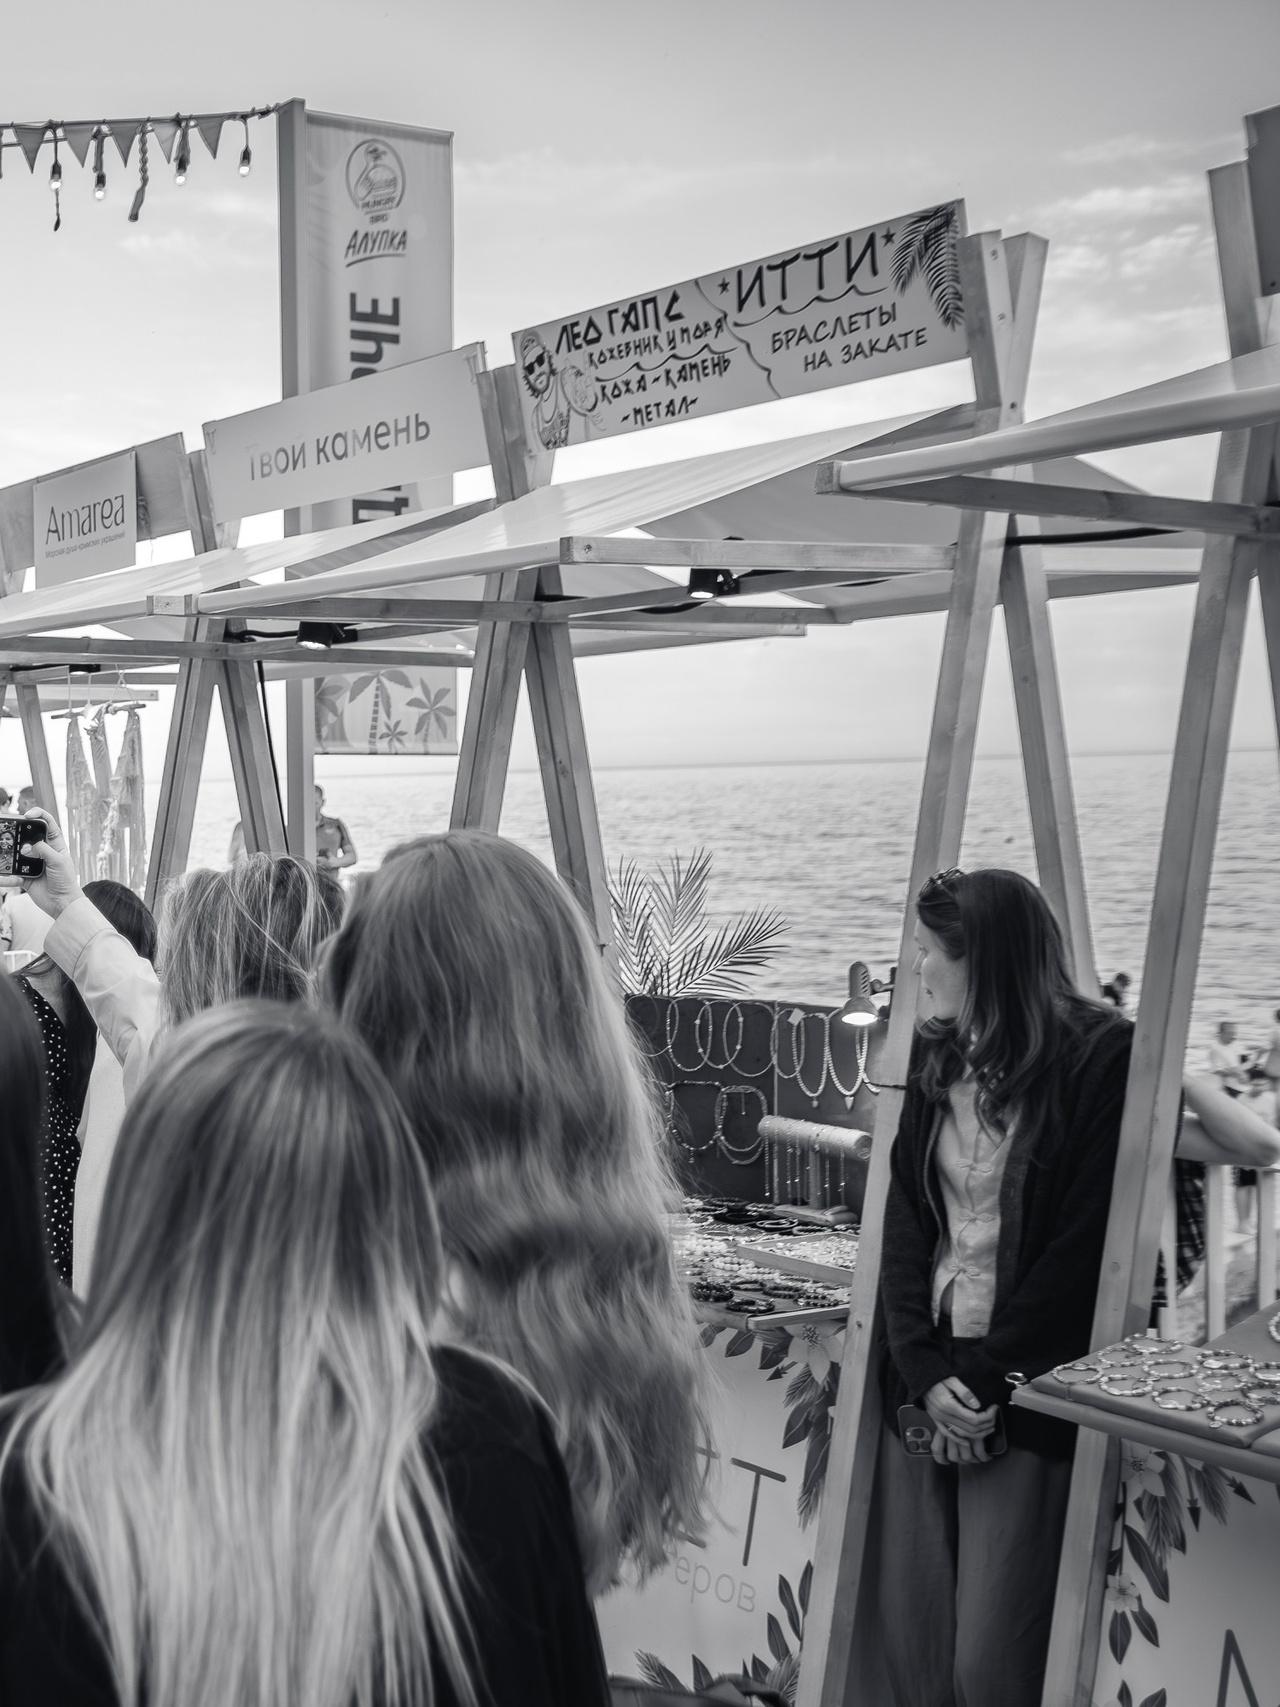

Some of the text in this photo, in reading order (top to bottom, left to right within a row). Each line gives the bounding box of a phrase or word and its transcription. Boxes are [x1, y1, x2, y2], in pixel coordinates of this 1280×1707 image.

[344, 229, 407, 259] АЛУПКА
[736, 231, 879, 314] ИТТИ
[588, 334, 665, 370] КОЖЕВНИК
[680, 314, 725, 344] МОРЯ
[771, 302, 898, 355] БРАСЛЕТЫ
[803, 327, 928, 374] НА ЗАКАТЕ
[316, 412, 431, 466] камень
[45, 494, 125, 545] Amarea
